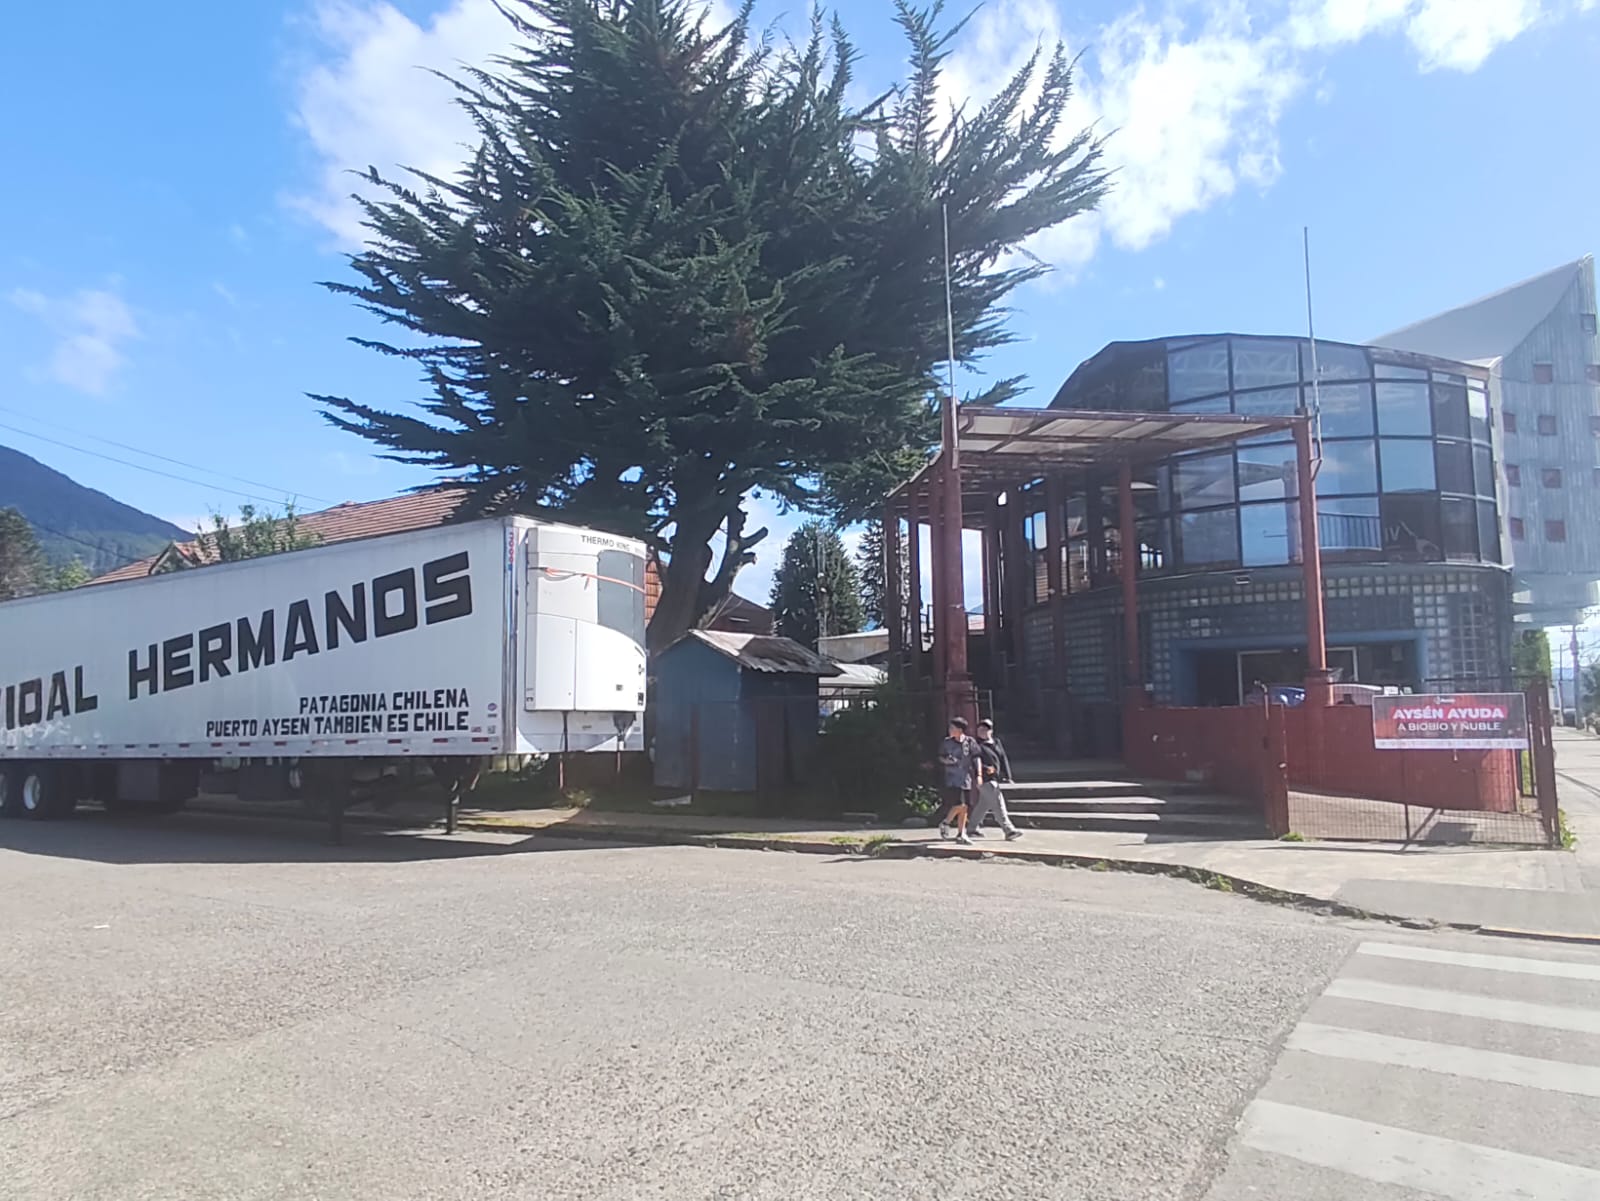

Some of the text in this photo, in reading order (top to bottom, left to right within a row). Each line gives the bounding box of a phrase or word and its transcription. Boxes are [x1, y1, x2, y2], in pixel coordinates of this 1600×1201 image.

[581, 535, 614, 547] THERMO
[0, 551, 473, 730] IDAL HERMANOS
[299, 688, 469, 715] PATAGONIA CHILENA
[1392, 706, 1504, 719] AYSÉN AYUDA
[206, 711, 469, 738] PUERTO AYSEN TAMBIEN ES CHILE
[1397, 722, 1406, 731] A
[1450, 722, 1458, 731] Y
